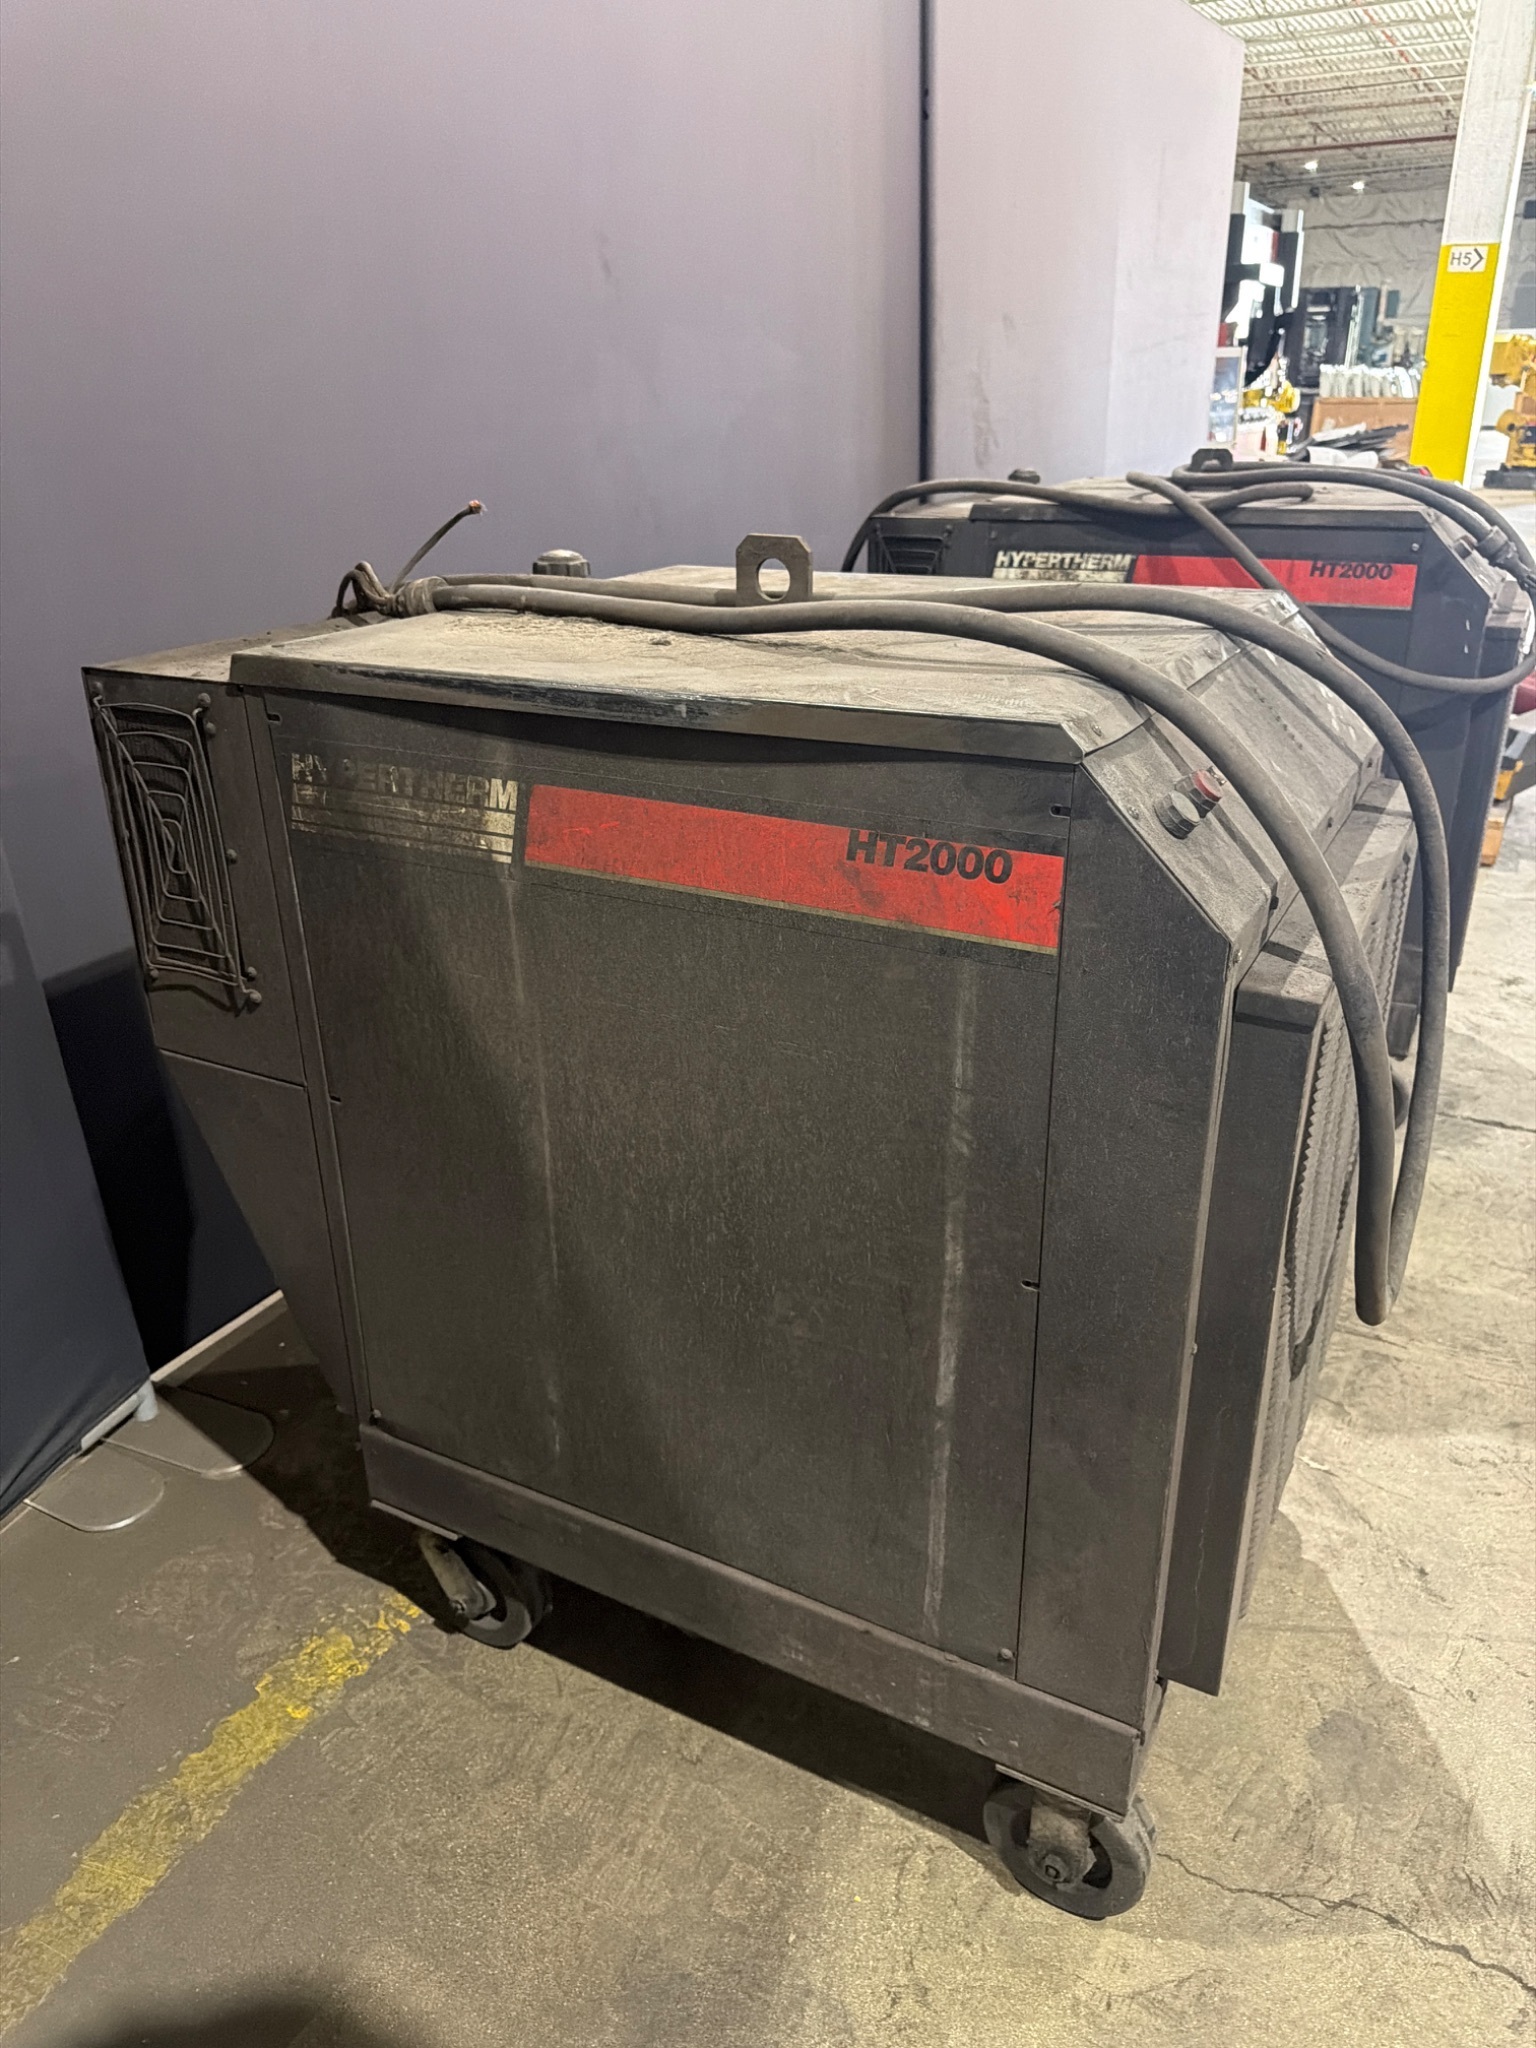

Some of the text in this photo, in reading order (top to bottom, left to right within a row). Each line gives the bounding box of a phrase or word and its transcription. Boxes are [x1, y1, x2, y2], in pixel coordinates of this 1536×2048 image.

[1450, 251, 1472, 266] H5
[996, 550, 1131, 570] HYPERTHERM
[1310, 560, 1393, 580] HT2000
[846, 829, 1013, 884] HT2000
